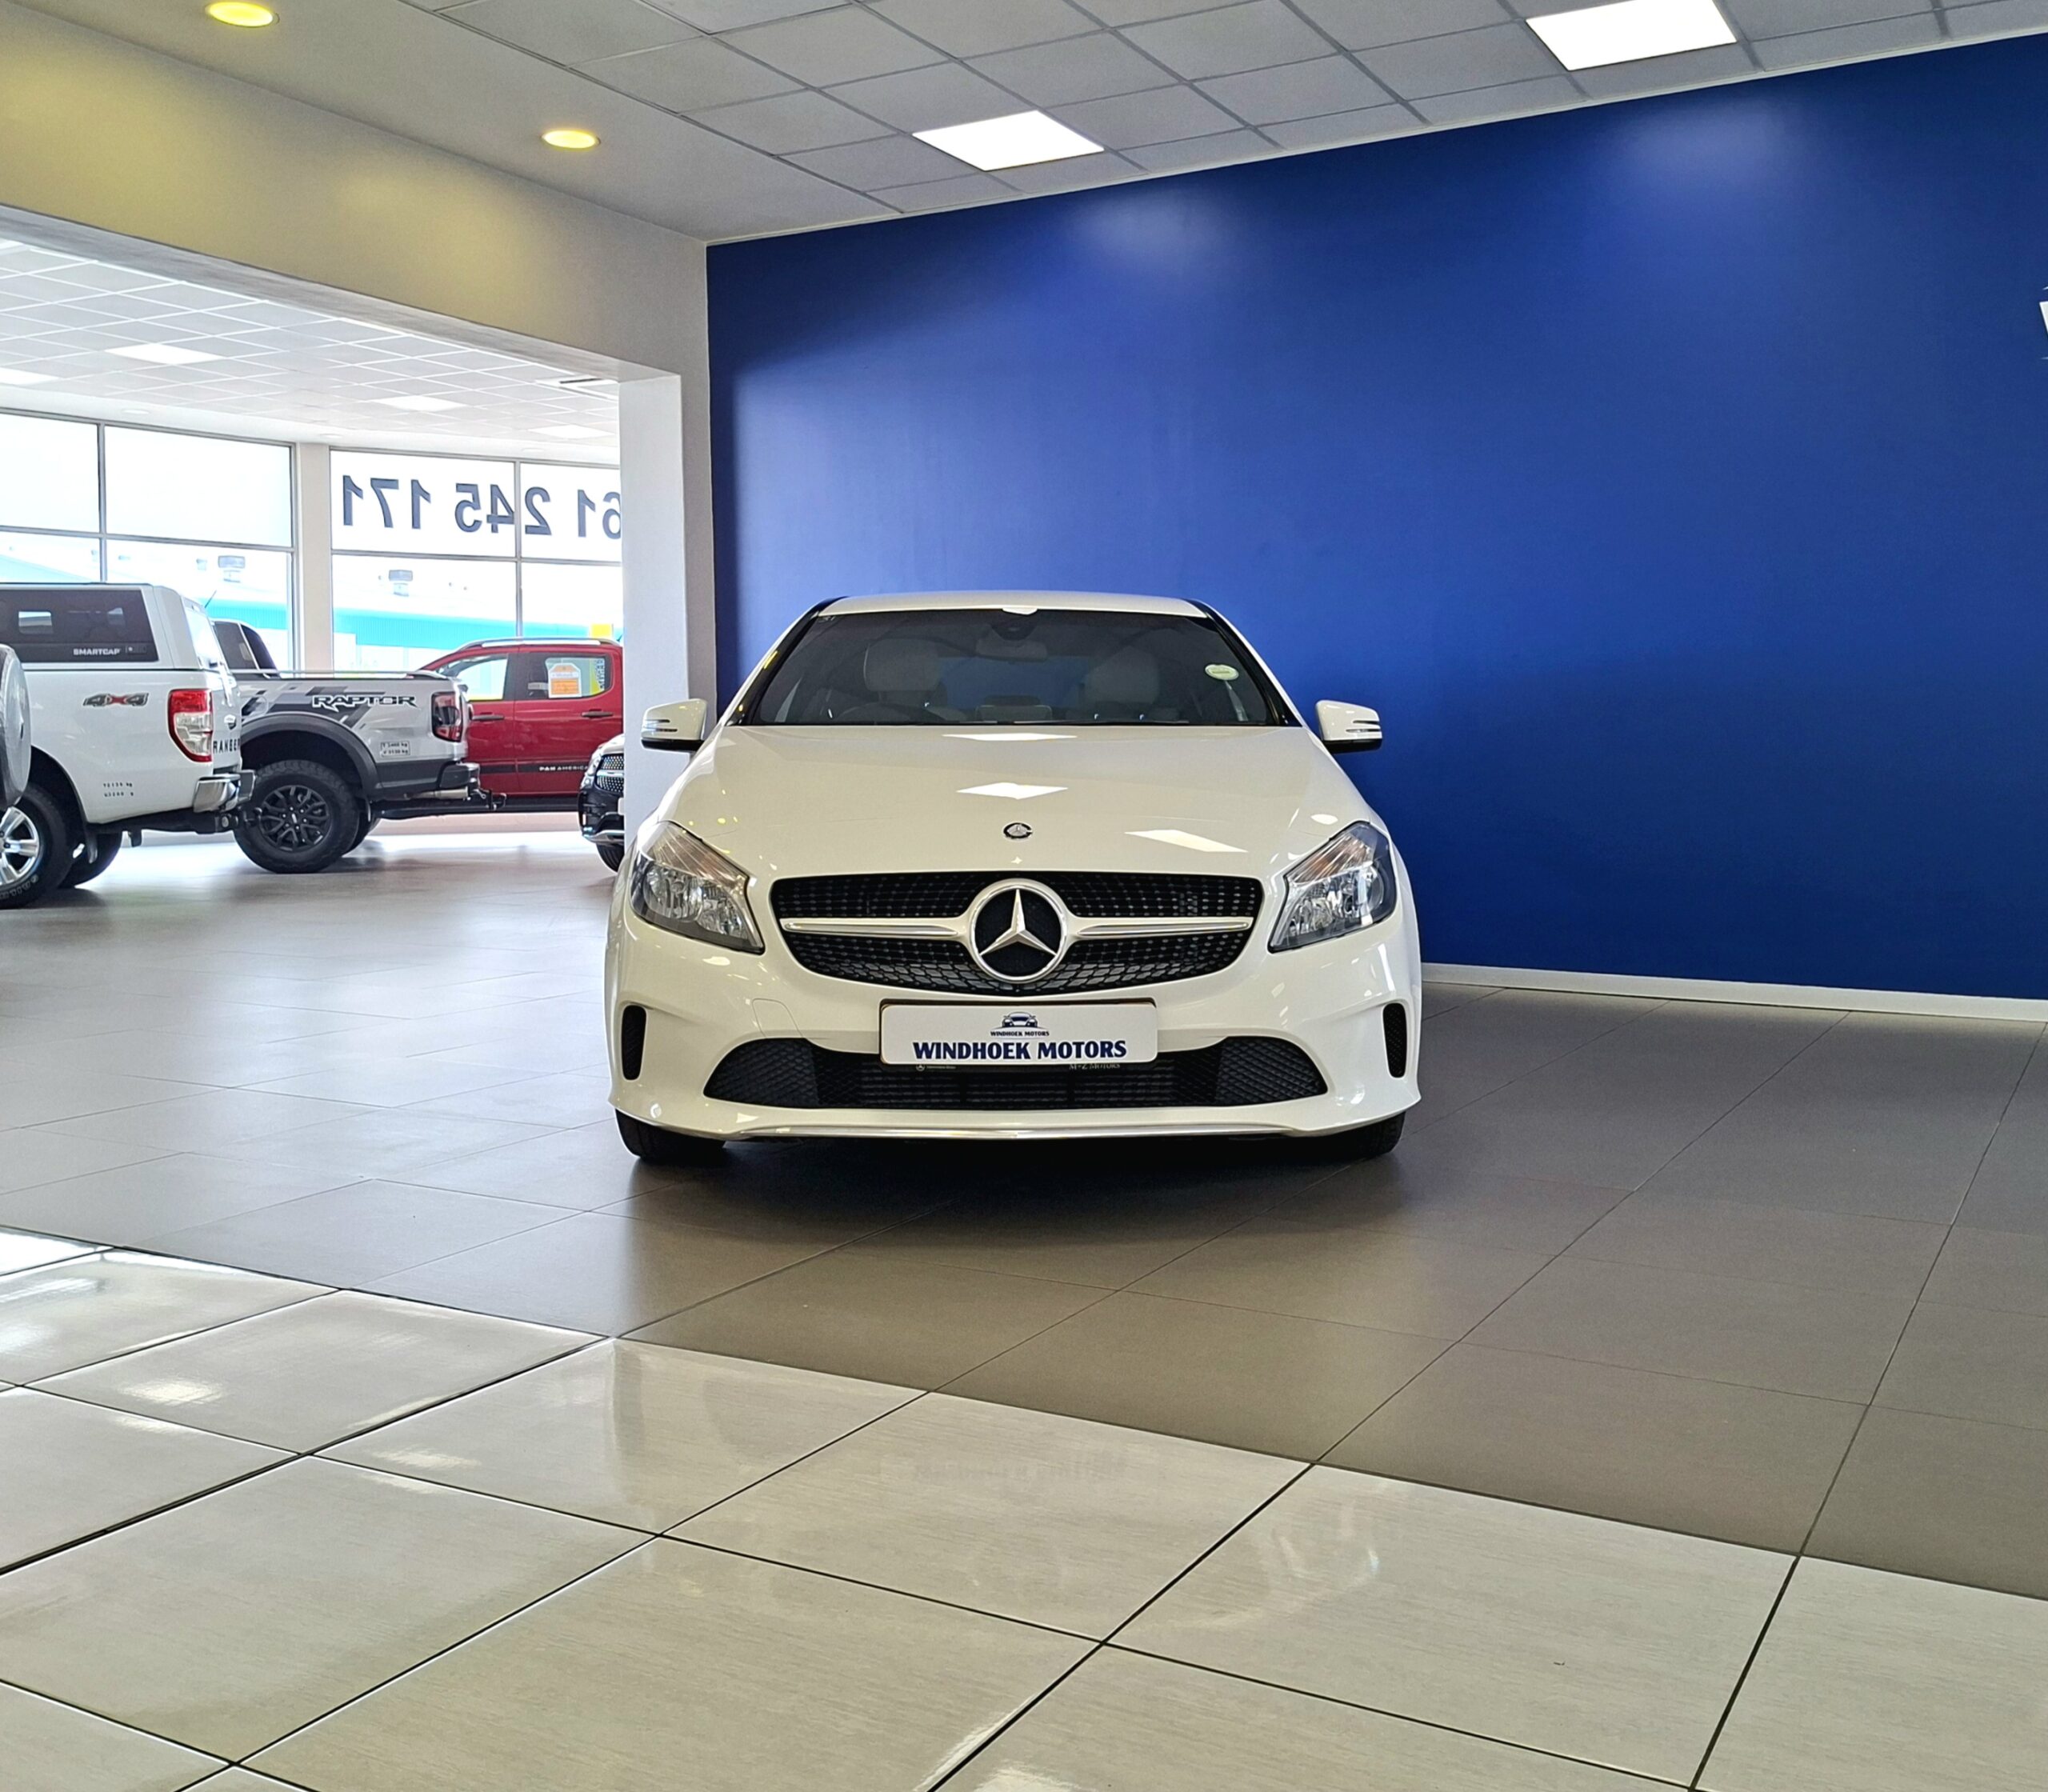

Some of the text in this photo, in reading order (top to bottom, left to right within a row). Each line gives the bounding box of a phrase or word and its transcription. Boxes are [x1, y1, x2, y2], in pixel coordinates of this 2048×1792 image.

[312, 694, 418, 712] RAPTOR
[913, 1040, 1127, 1060] WINDHOEK MOTORS
